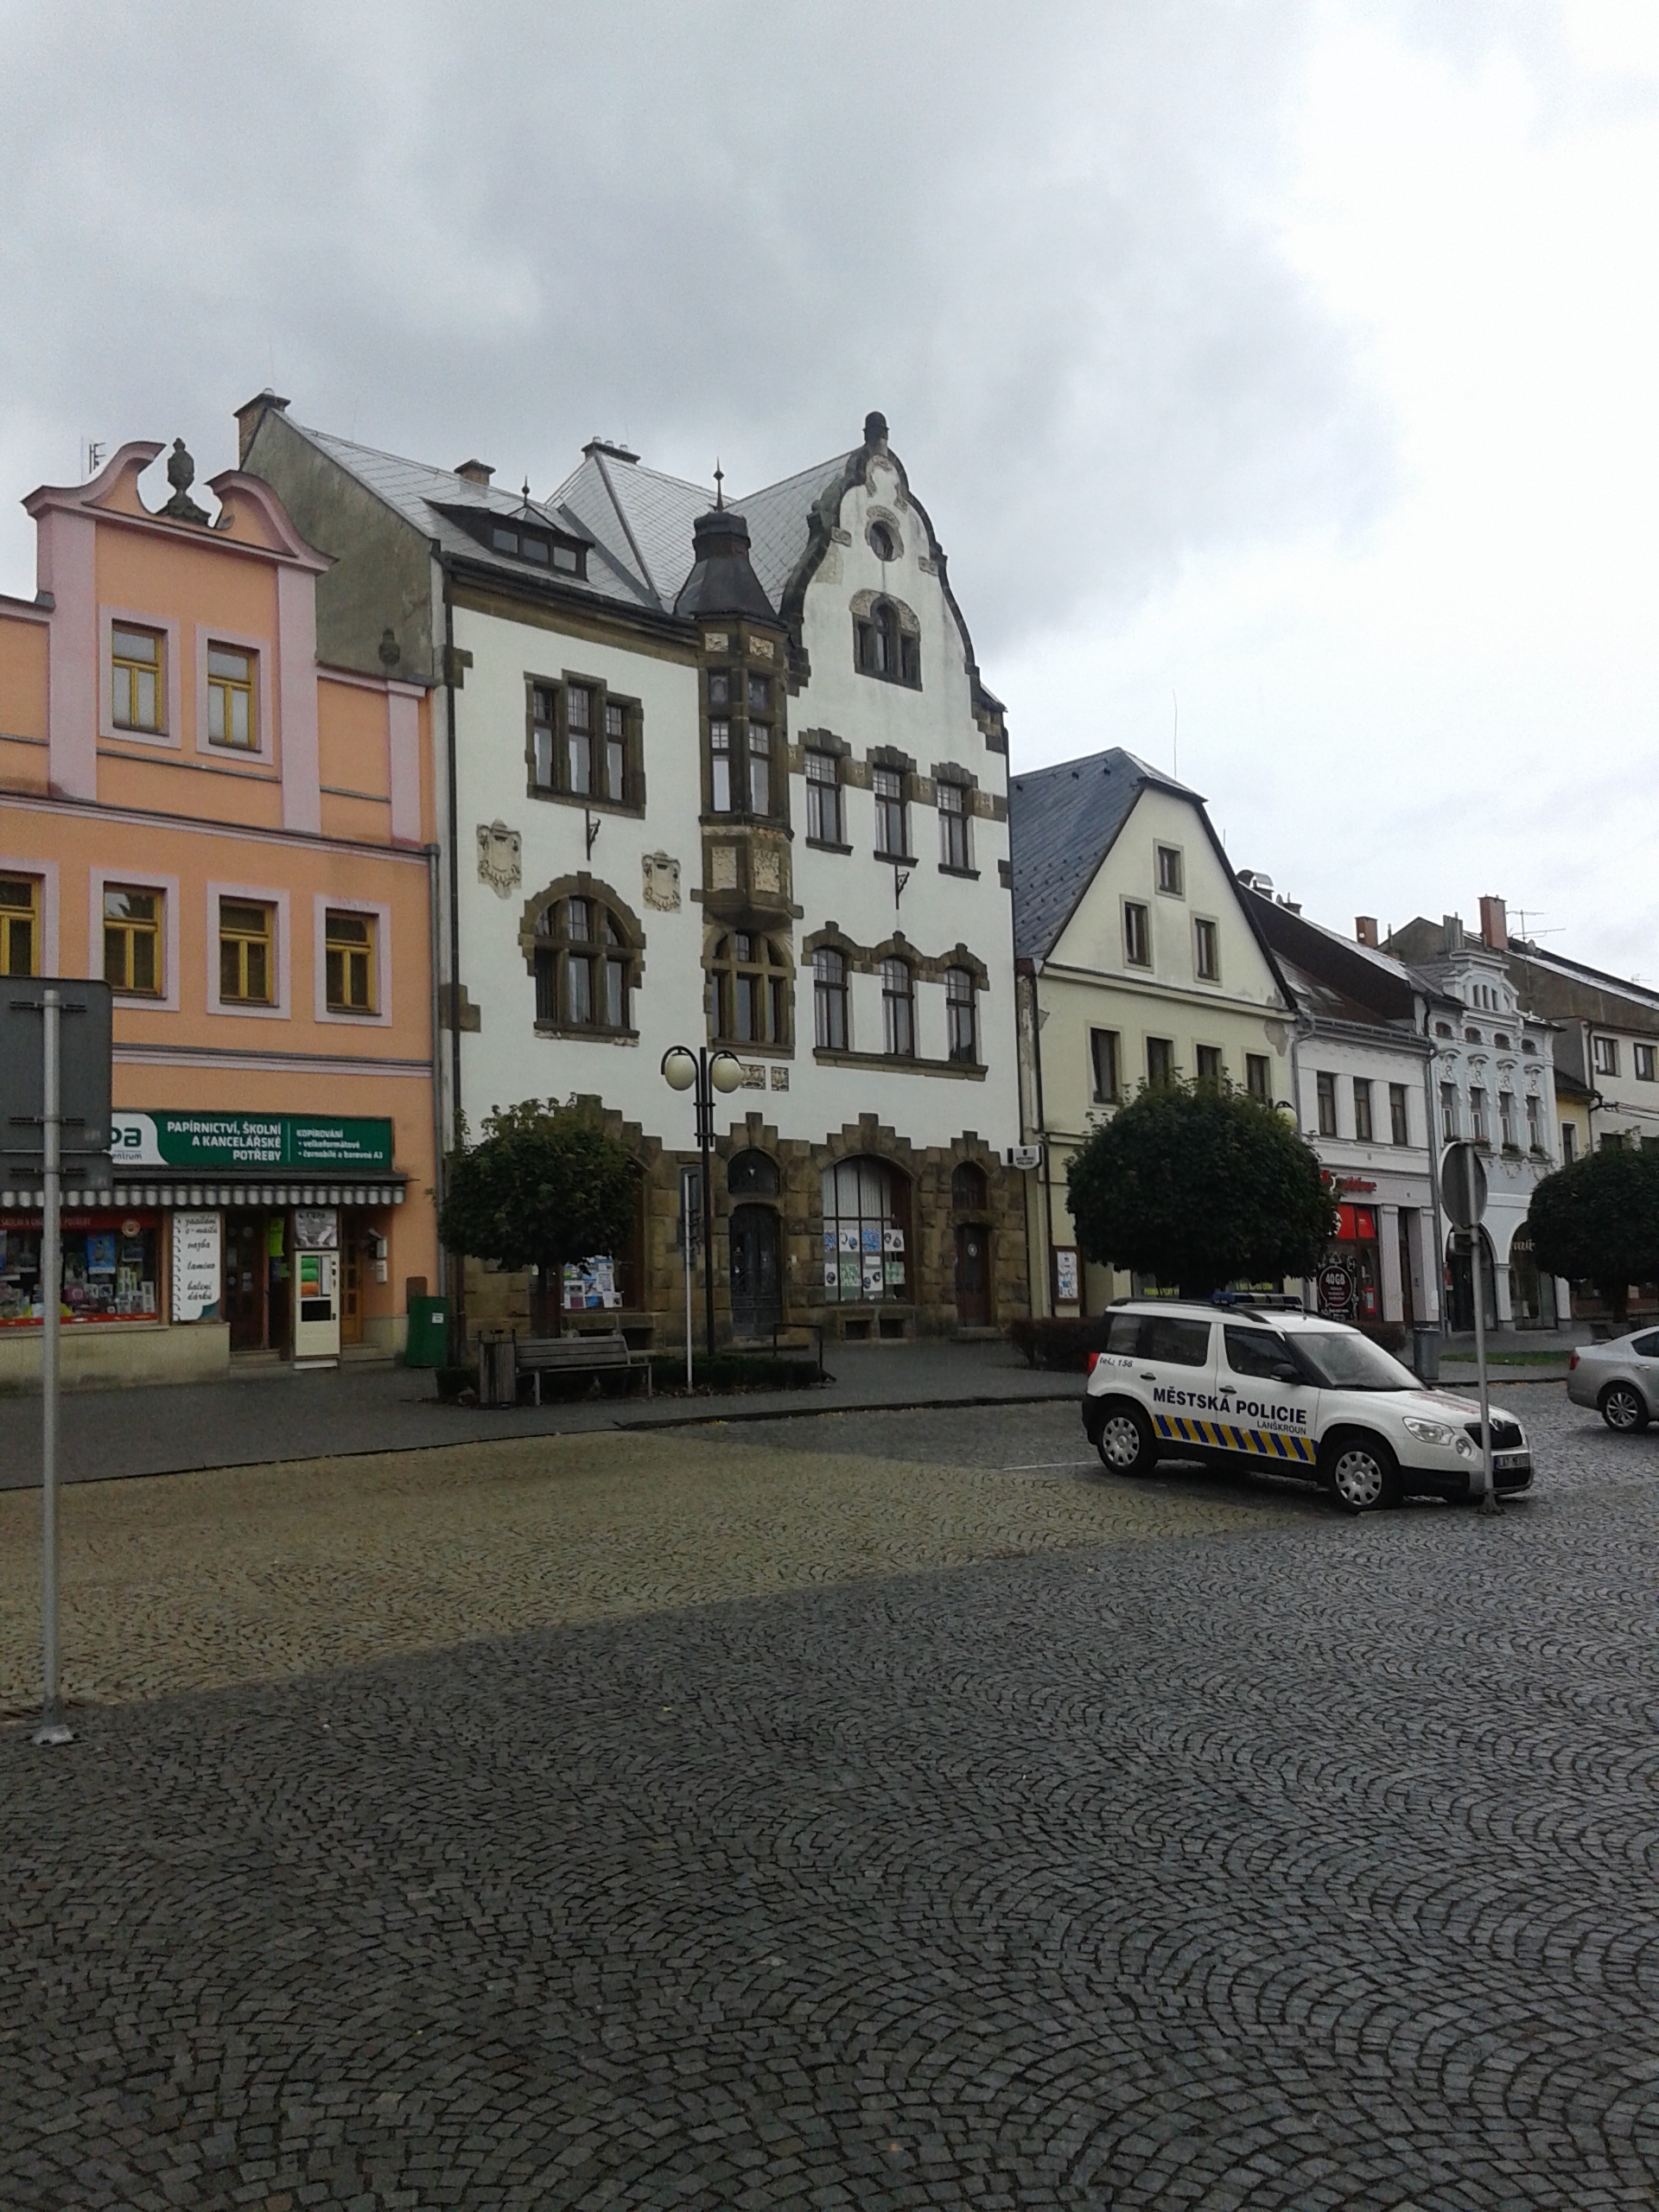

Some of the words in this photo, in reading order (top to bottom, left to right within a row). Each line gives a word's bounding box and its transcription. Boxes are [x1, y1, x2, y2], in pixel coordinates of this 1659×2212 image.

[167, 1119, 240, 1135] PAPÍRNICTVÍ,
[243, 1120, 282, 1135] ŠKOLNÍ
[192, 1136, 200, 1147] A
[202, 1135, 282, 1148] KANCELÁŘSKÉ
[232, 1147, 282, 1161] POTŘEBY
[1099, 1357, 1116, 1367] tel.:
[1117, 1359, 1133, 1368] 156
[1153, 1386, 1230, 1414] MĚSTSKÁ
[1236, 1400, 1307, 1425] POLICIE
[1256, 1420, 1306, 1435] LANŠKROUN
